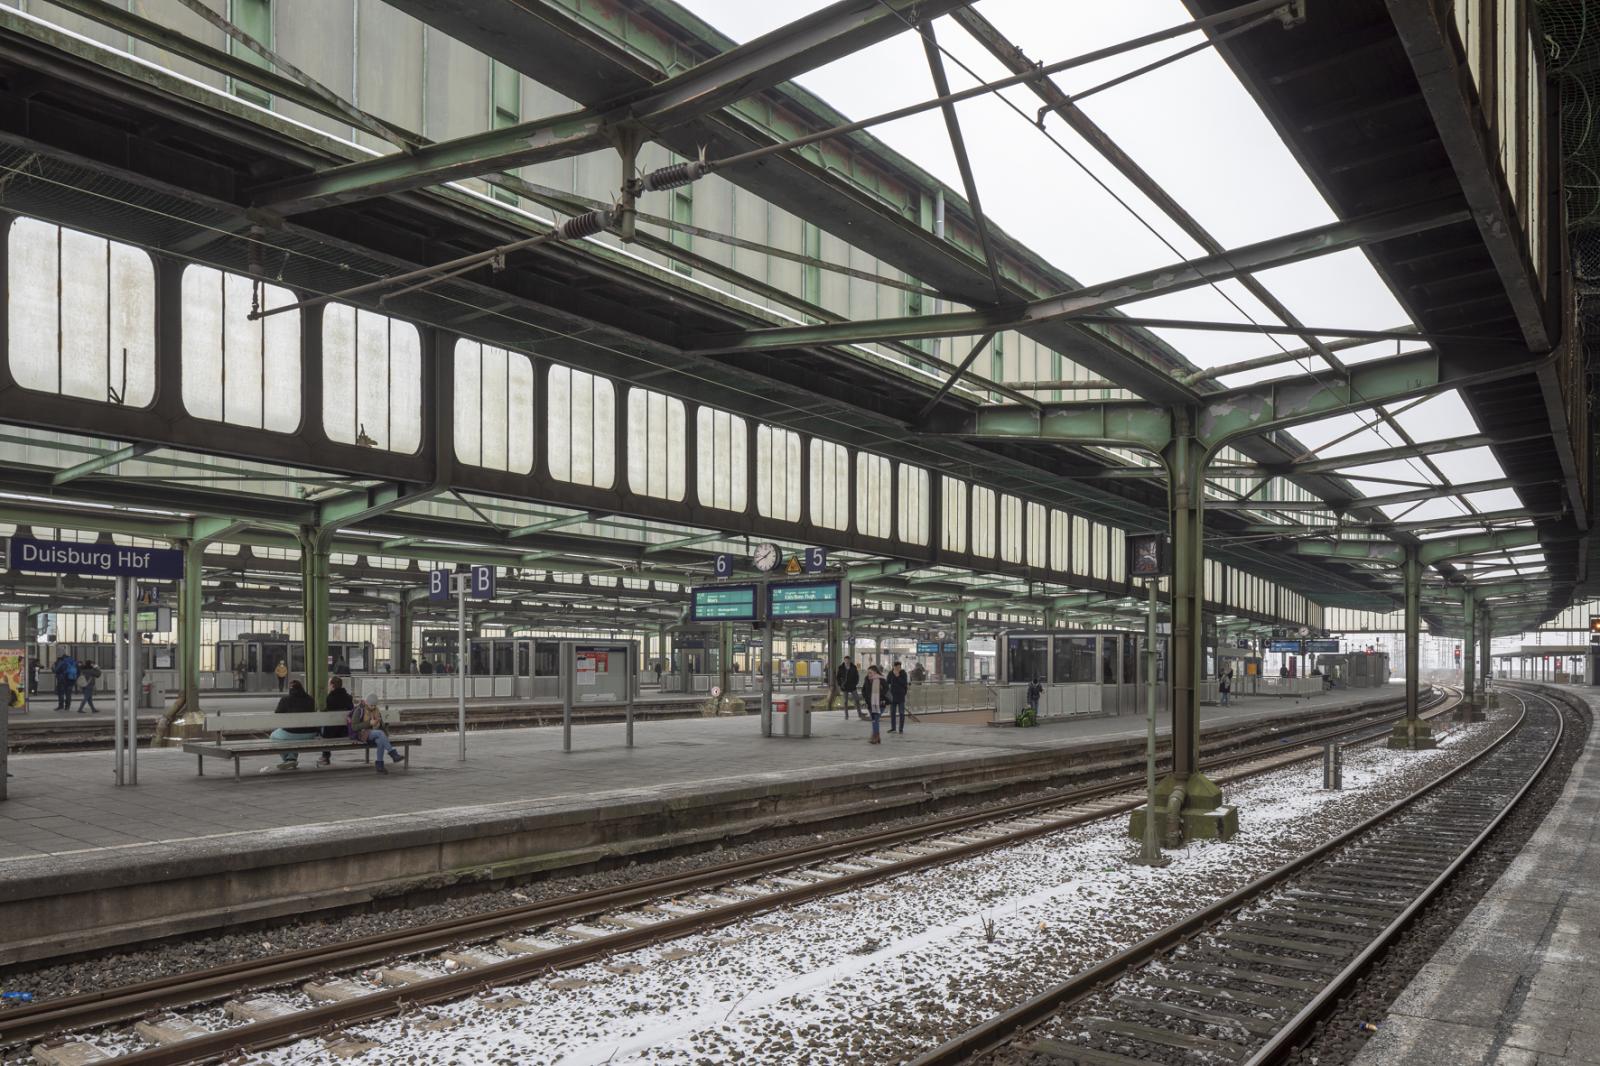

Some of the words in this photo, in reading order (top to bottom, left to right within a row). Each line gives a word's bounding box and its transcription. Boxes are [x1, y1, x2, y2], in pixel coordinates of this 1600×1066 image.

[22, 544, 112, 570] Duisburg
[118, 551, 150, 569] Hbf
[716, 555, 726, 572] 6
[813, 548, 823, 566] 5
[431, 571, 442, 594] B
[478, 567, 490, 591] B
